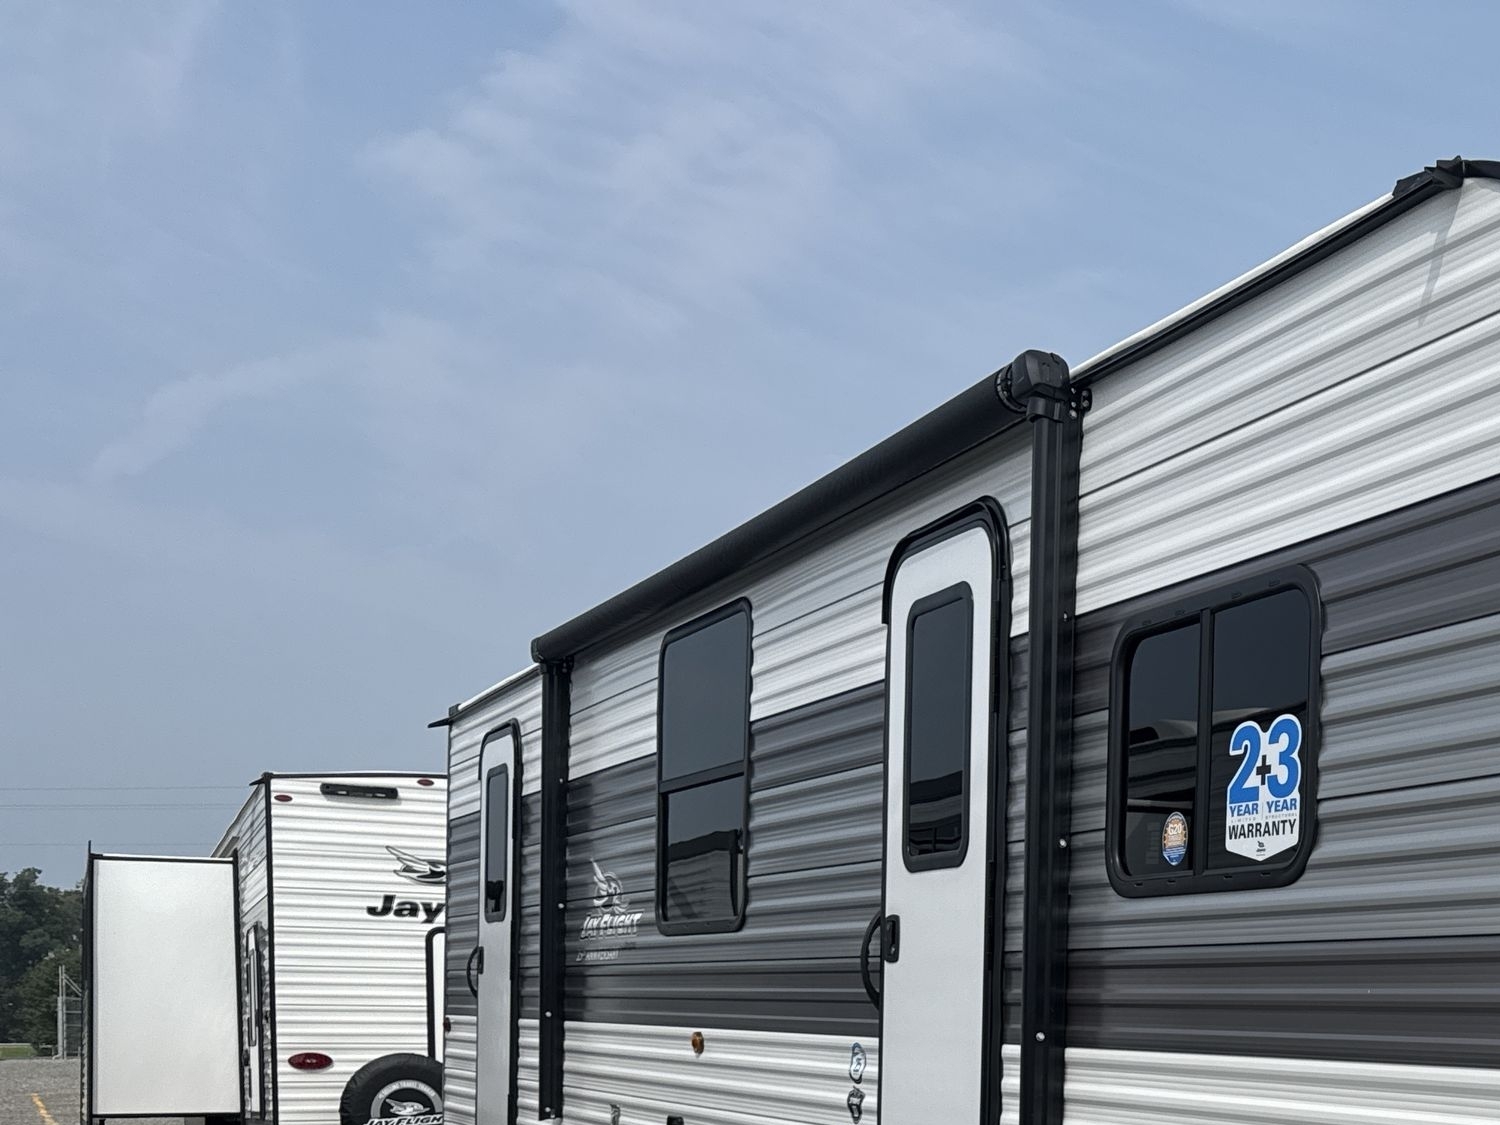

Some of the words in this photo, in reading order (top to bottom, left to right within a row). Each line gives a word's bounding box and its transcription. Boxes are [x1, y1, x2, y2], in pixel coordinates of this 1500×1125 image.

[1229, 803, 1259, 818] YEAR
[1266, 798, 1297, 814] YEAR
[1228, 819, 1297, 840] WARRANTY
[366, 894, 447, 925] Jay
